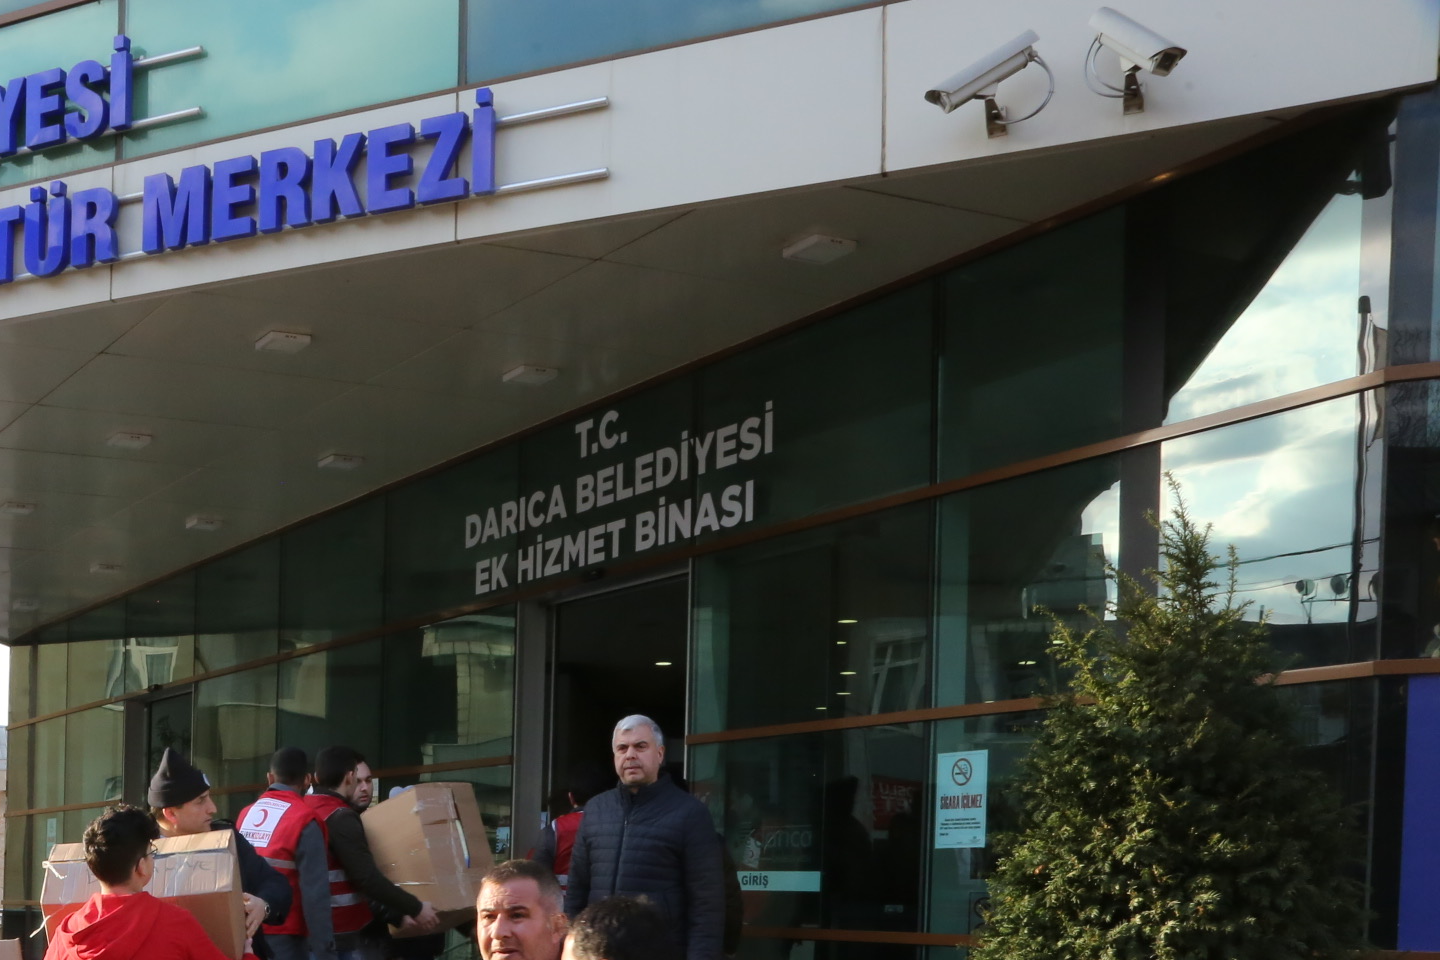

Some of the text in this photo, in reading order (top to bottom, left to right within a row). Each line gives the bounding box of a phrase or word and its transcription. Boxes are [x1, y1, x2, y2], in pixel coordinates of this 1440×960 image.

[143, 87, 497, 254] MERKEZİ
[465, 400, 774, 549] DARICA BELEDİYESİ
[575, 410, 628, 458] T.C.
[475, 480, 754, 595] EK HİZMET BİNASI
[741, 873, 769, 888] GİRİŞ
